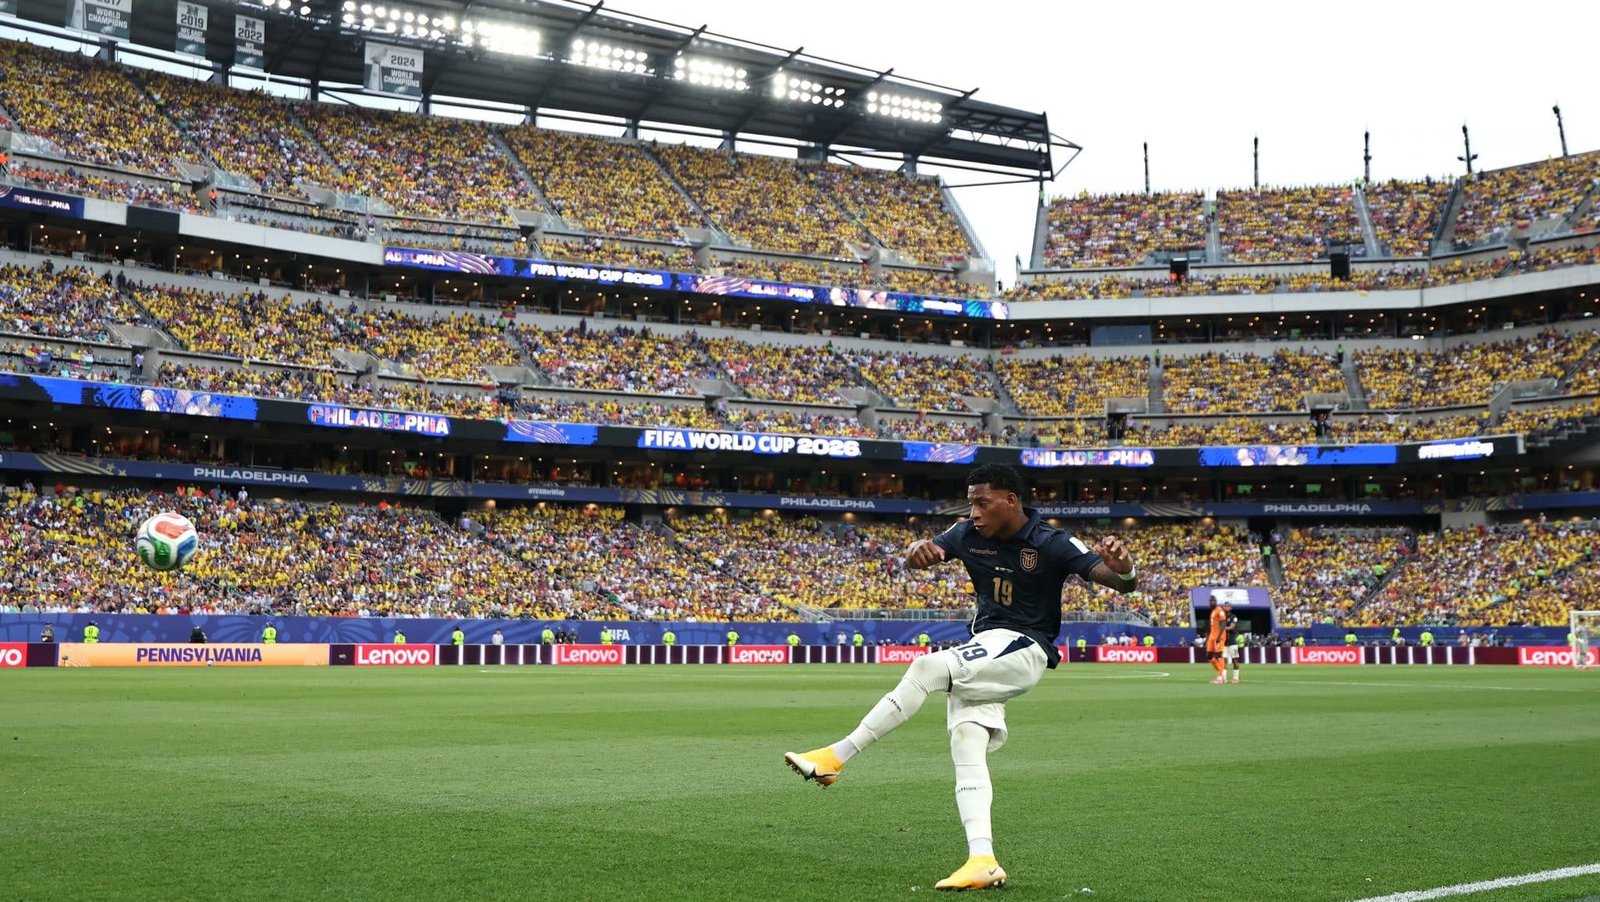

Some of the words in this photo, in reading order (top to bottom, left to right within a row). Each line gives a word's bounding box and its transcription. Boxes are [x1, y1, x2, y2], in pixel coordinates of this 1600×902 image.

[88, 13, 128, 29] CHAMPIONS
[96, 8, 121, 20] WORLD
[181, 14, 204, 29] 2019
[238, 28, 262, 42] 2022
[390, 55, 415, 67] 2024
[383, 75, 420, 88] CHAMPIONS
[391, 69, 414, 80] WORLD
[530, 264, 557, 276] FIFA
[557, 266, 599, 280] WORLD
[600, 270, 623, 281] CUP
[310, 405, 449, 435] PHILADELPHIA
[644, 430, 687, 448] FIFA
[687, 432, 756, 451] WORLD
[758, 436, 795, 453] CUP
[796, 438, 860, 457] 2026
[1022, 449, 1154, 466] PHILADELPHIA
[193, 467, 309, 484] PHILADELPHIA
[780, 497, 875, 509] PHILADELPHIA
[1062, 507, 1079, 515] CUP
[1080, 506, 1110, 515] 2026
[1263, 504, 1371, 512] PHILADELPHIA
[992, 577, 1013, 606] 19
[608, 629, 631, 641] IFA
[136, 647, 263, 662] PENNSYLVANIA
[358, 645, 430, 665] Lenovo
[561, 646, 619, 663] Lenovo
[731, 646, 784, 663] Lenovo
[957, 642, 988, 661] 19
[1098, 646, 1154, 662] Lenovo
[1299, 647, 1356, 663] Lenovo
